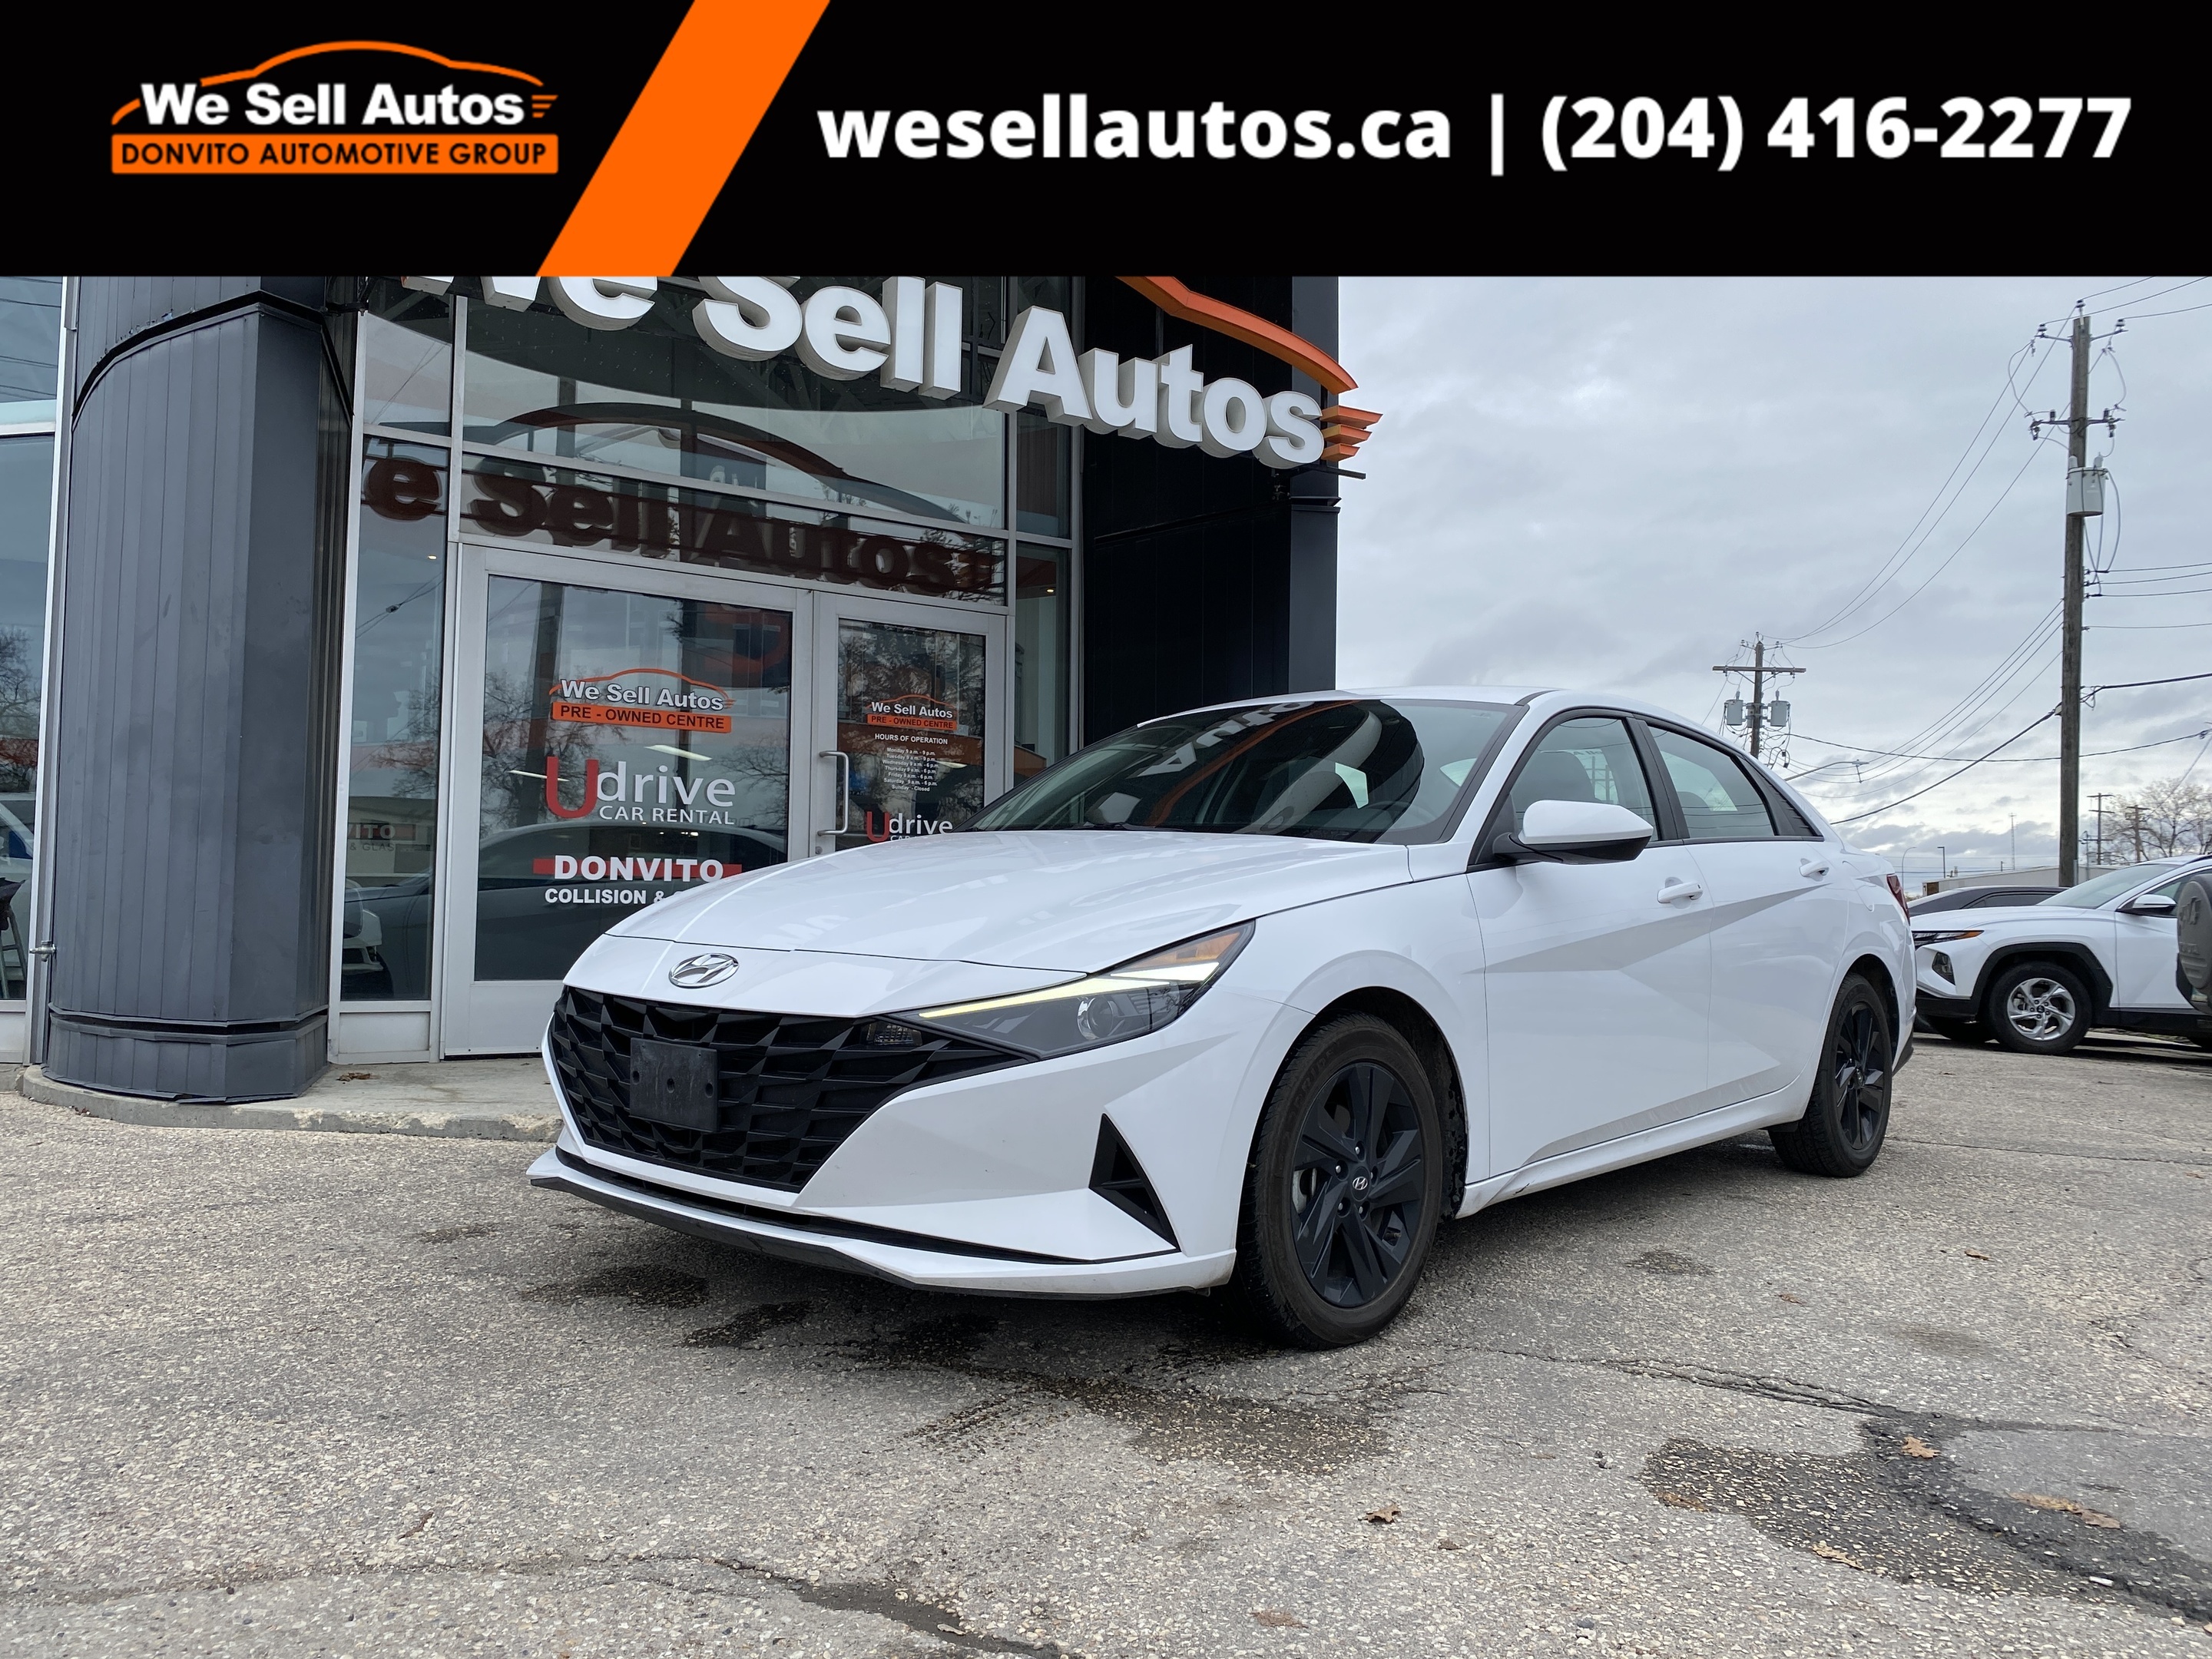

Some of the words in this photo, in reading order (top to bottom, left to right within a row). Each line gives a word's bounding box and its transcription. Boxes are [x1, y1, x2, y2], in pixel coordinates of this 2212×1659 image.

[693, 276, 962, 400] Sell
[983, 306, 1324, 469] Autos
[561, 679, 600, 700] We
[607, 684, 650, 705] Sell
[657, 688, 724, 711] Autos
[560, 705, 591, 719] PRE
[605, 708, 661, 724] OWNED
[666, 713, 724, 729] CENTRE
[872, 701, 891, 714] We
[894, 704, 916, 716] Sell
[919, 706, 953, 719] Autos
[893, 717, 922, 727] OWNED
[923, 720, 953, 729] CENTRE
[875, 733, 899, 742] HOURS
[911, 736, 949, 745] OPERATION
[546, 756, 736, 819] Udrive
[599, 806, 644, 820] CAR
[653, 808, 735, 825] RENTAL
[866, 811, 953, 843] Udrive
[555, 855, 724, 882] DONVITO
[545, 888, 647, 905] COLLISION
